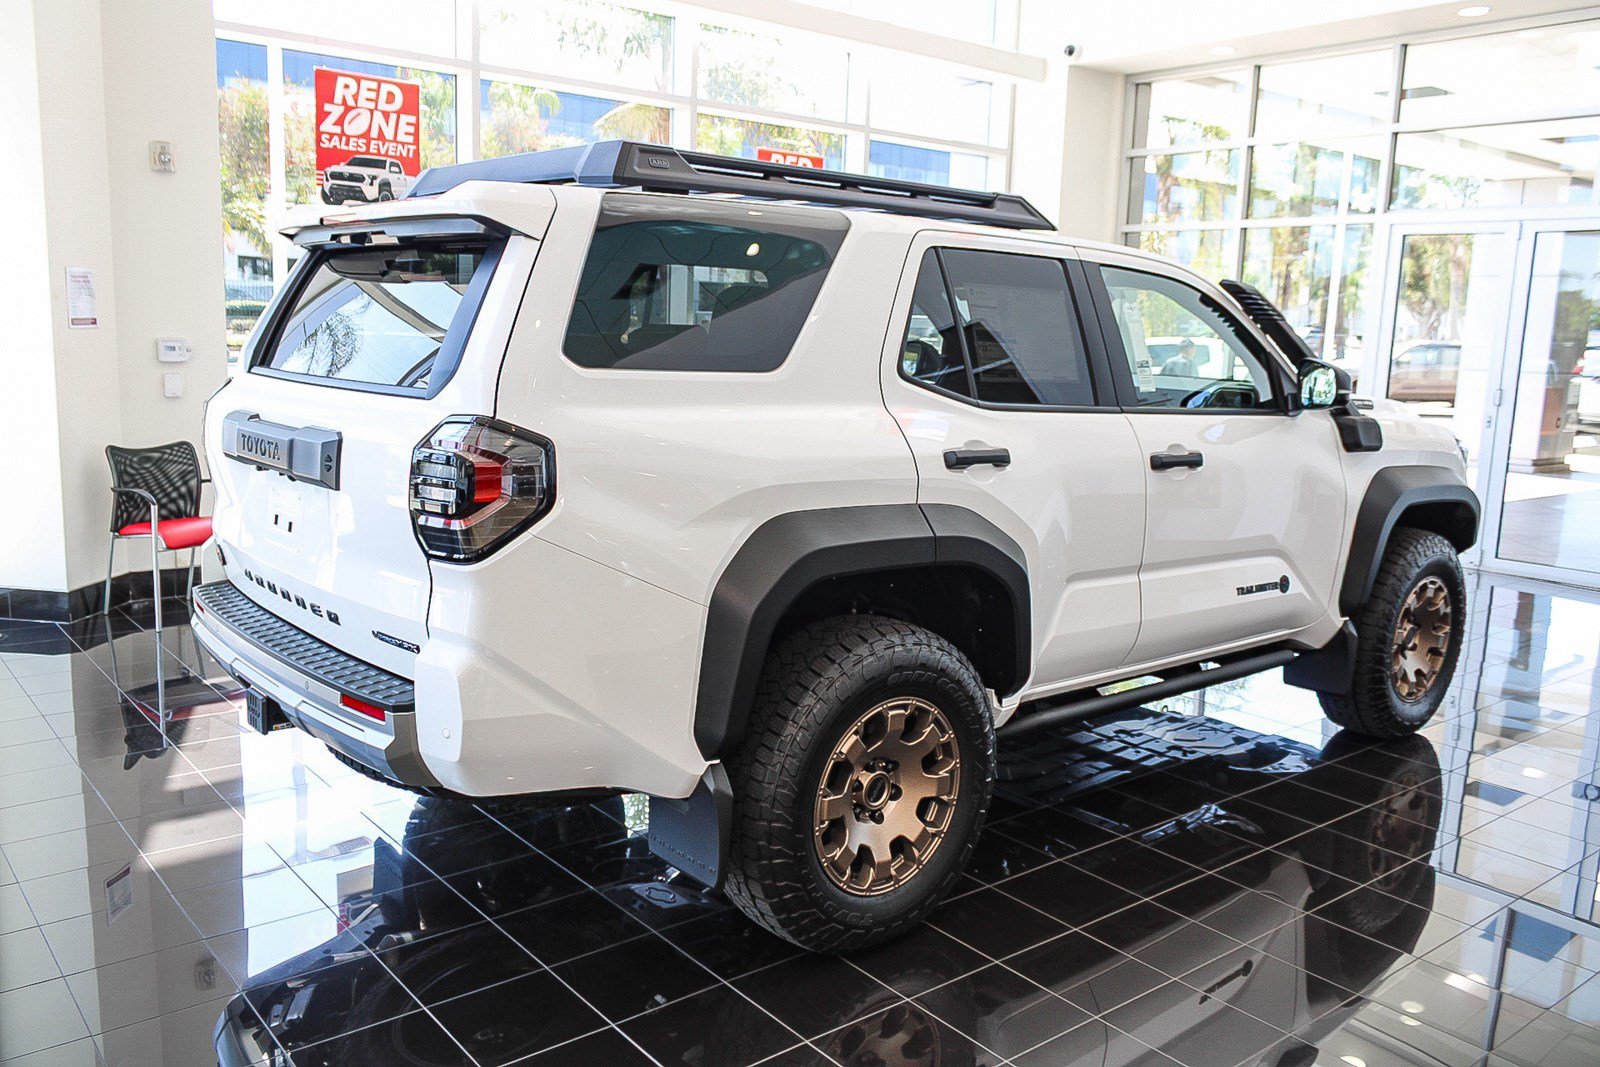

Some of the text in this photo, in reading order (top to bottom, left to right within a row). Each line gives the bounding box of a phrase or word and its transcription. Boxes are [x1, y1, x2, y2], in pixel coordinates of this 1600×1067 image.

[334, 75, 404, 112] RED
[319, 103, 417, 143] ZONE
[320, 134, 417, 158] SALES EVENT
[241, 433, 281, 461] TOYOTA
